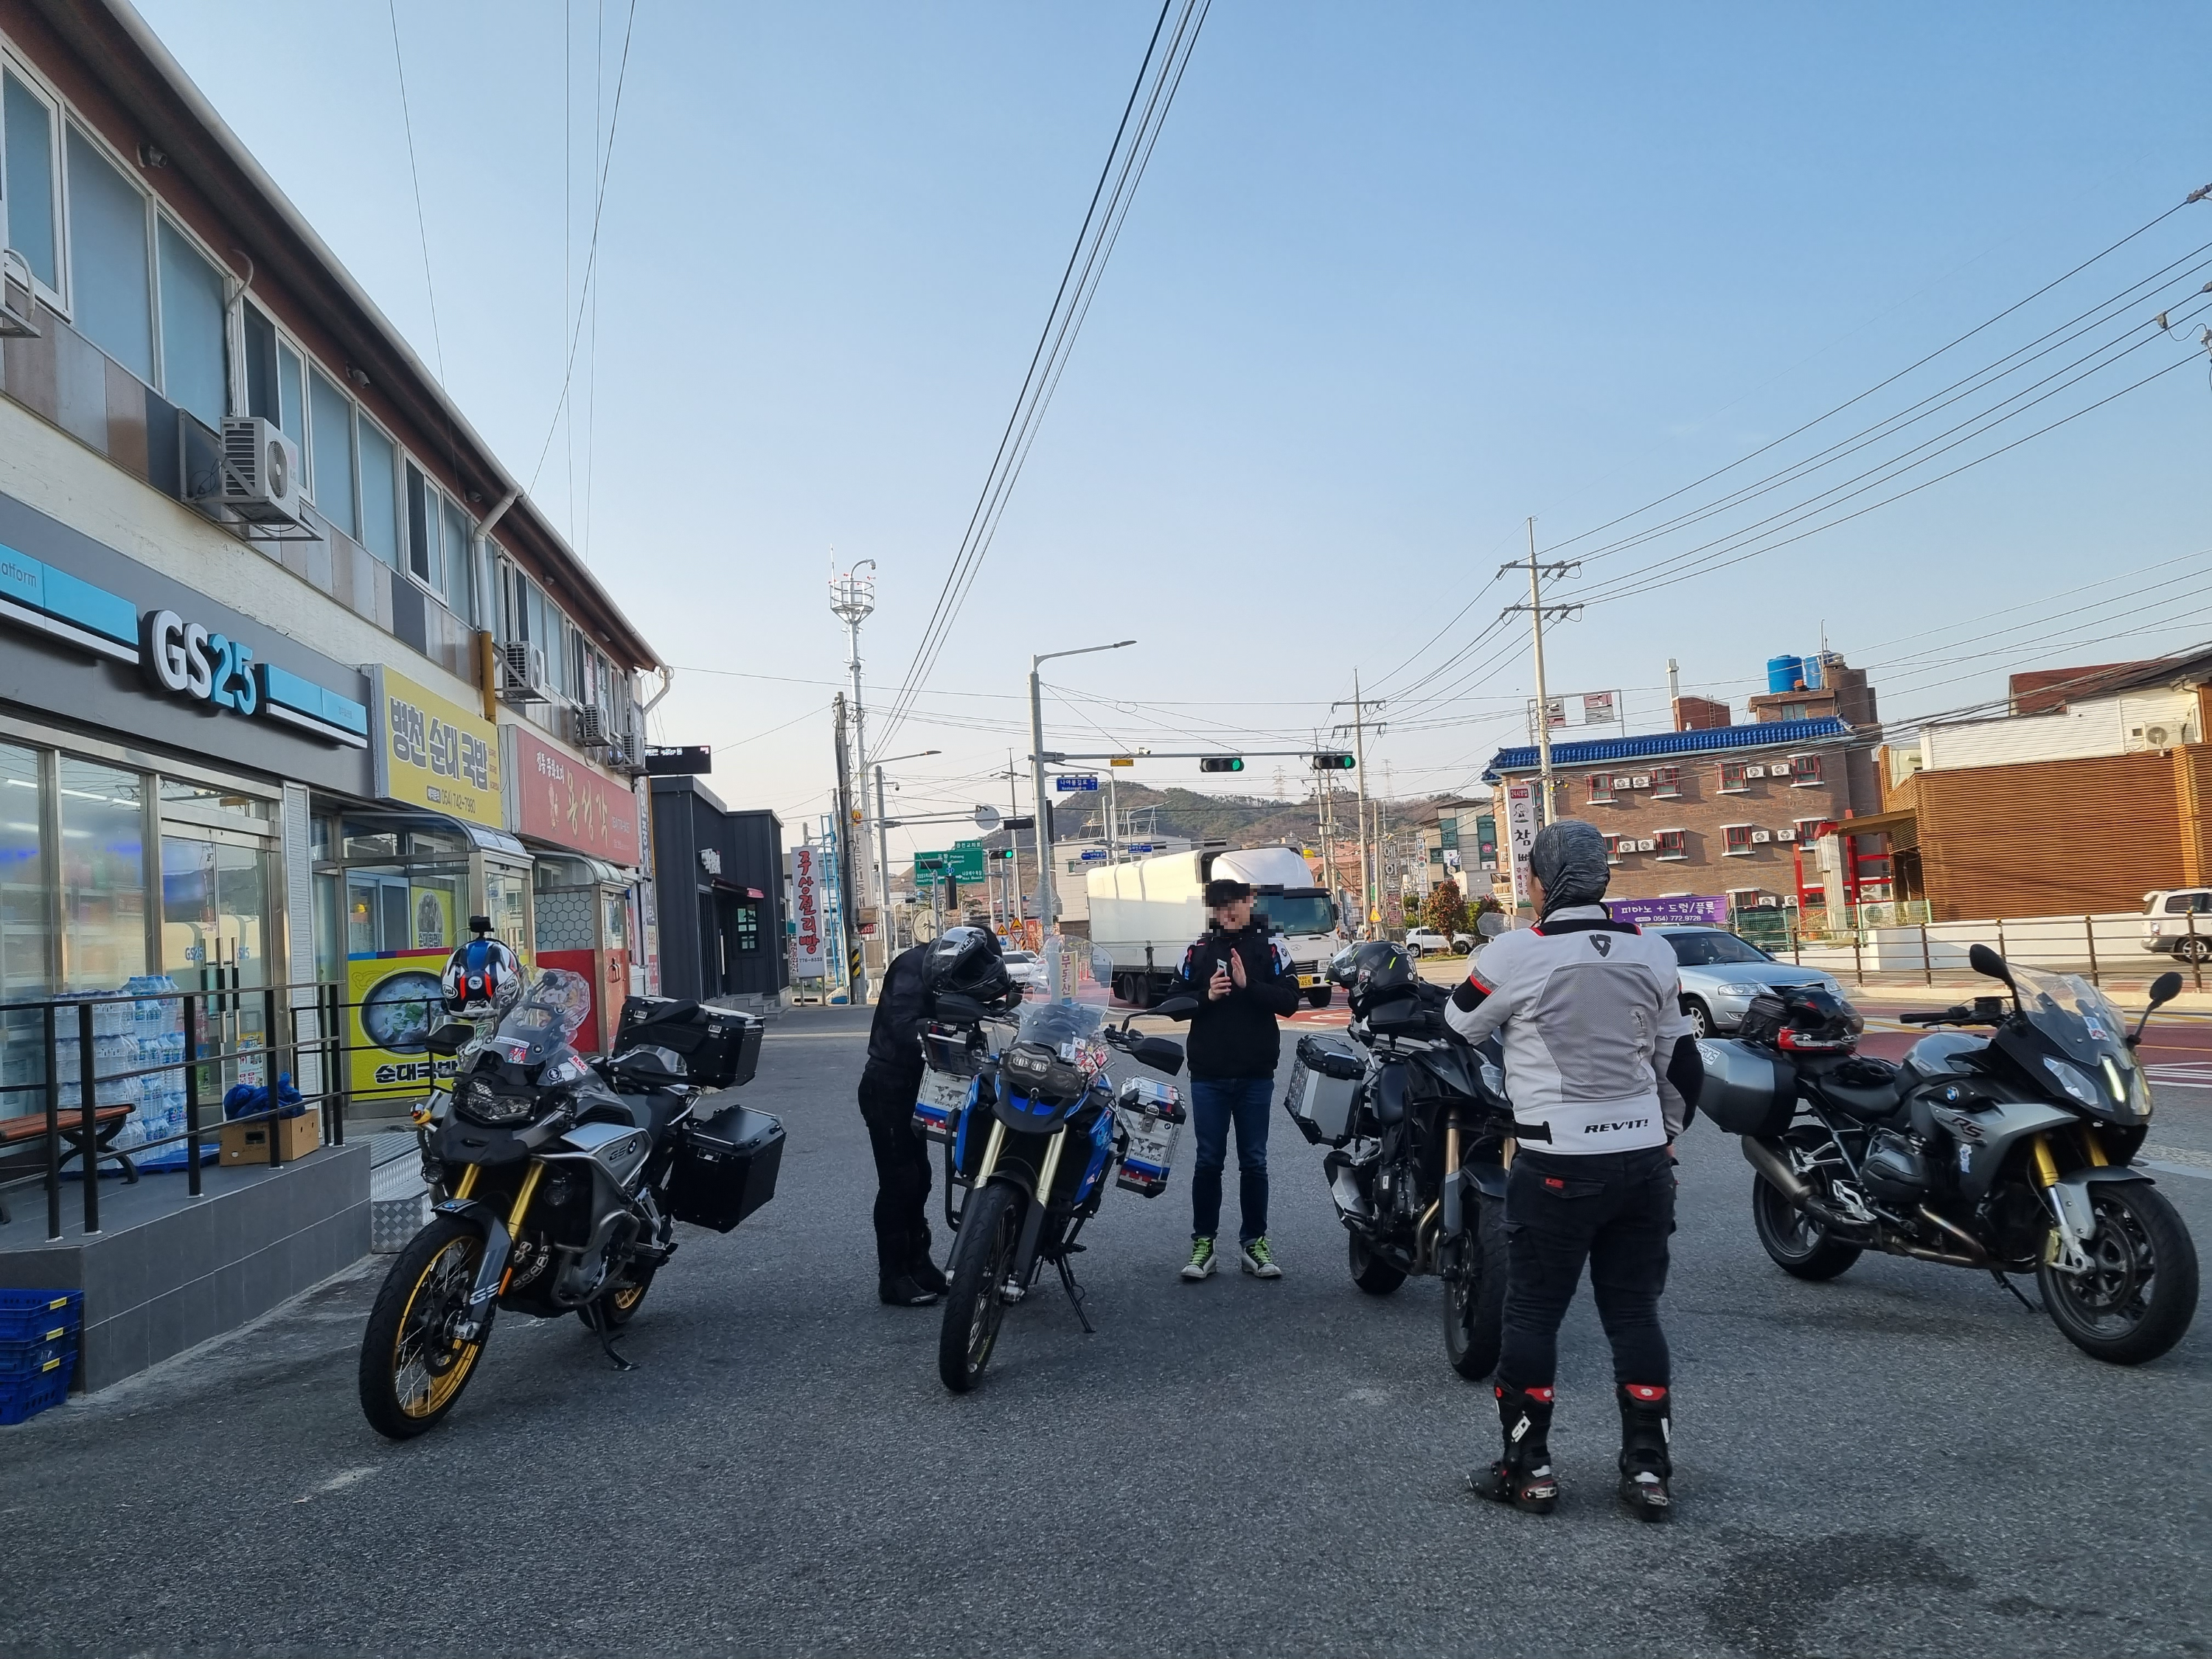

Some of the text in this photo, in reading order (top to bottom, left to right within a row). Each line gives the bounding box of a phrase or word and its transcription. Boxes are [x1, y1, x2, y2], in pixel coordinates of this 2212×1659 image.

[150, 609, 257, 716] GS25
[389, 695, 427, 770] 병천
[428, 717, 460, 781] 순대
[461, 731, 489, 793] 국밥
[798, 850, 821, 954] 주상절리빵
[1621, 905, 1652, 914] 피아노
[185, 947, 204, 961] GS25
[961, 938, 975, 951] HJC
[1061, 954, 1071, 996] 부동산
[1585, 1119, 1649, 1134] REV'IT!
[1952, 1116, 1986, 1138] RS
[609, 1146, 627, 1162] GS
[469, 1281, 501, 1306] GS
